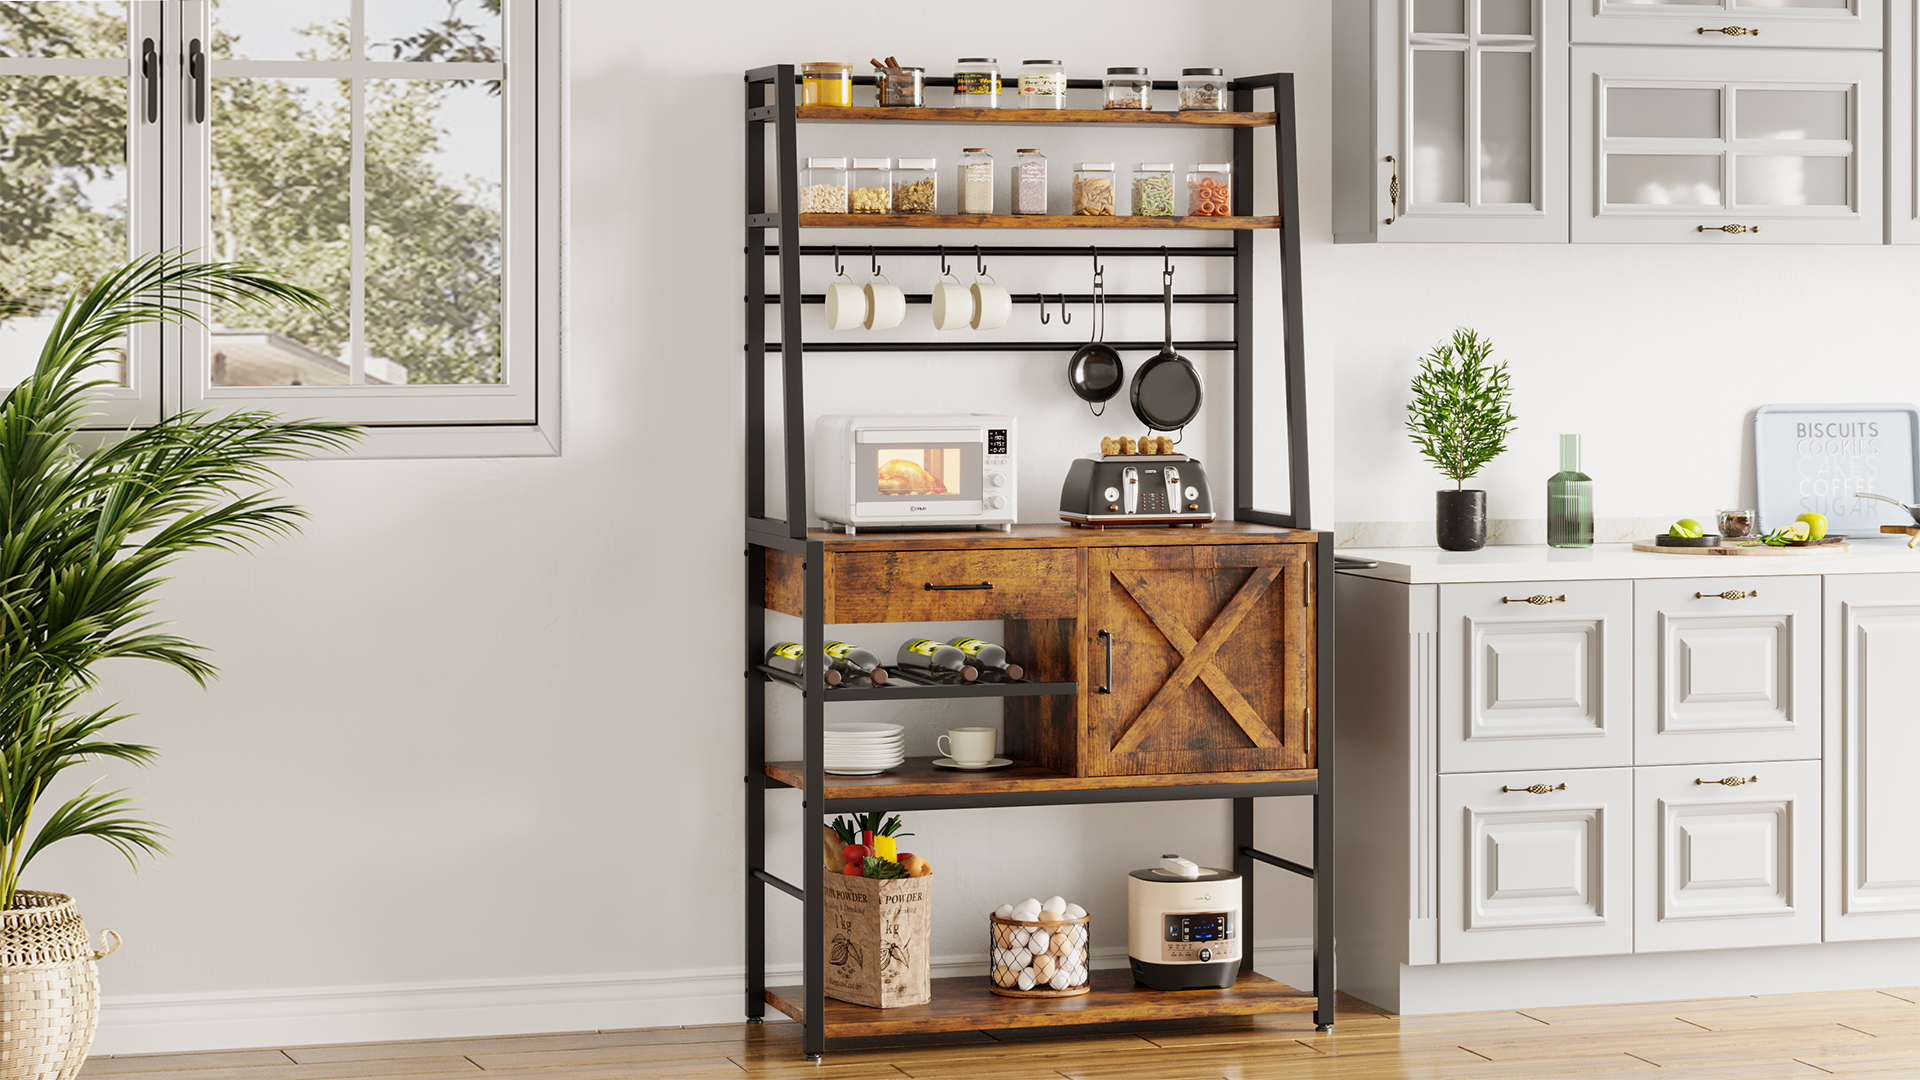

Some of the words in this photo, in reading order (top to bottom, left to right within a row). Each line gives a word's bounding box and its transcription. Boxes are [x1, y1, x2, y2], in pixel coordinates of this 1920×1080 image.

[1797, 422, 1879, 438] BISCUITS
[1796, 439, 1879, 456] COOKIES
[1797, 455, 1878, 478] CAKES
[1800, 497, 1879, 517] SUGAR
[836, 890, 868, 904] POWDER
[885, 892, 923, 905] POWDER
[841, 914, 852, 935] kg
[885, 919, 900, 939] kg
